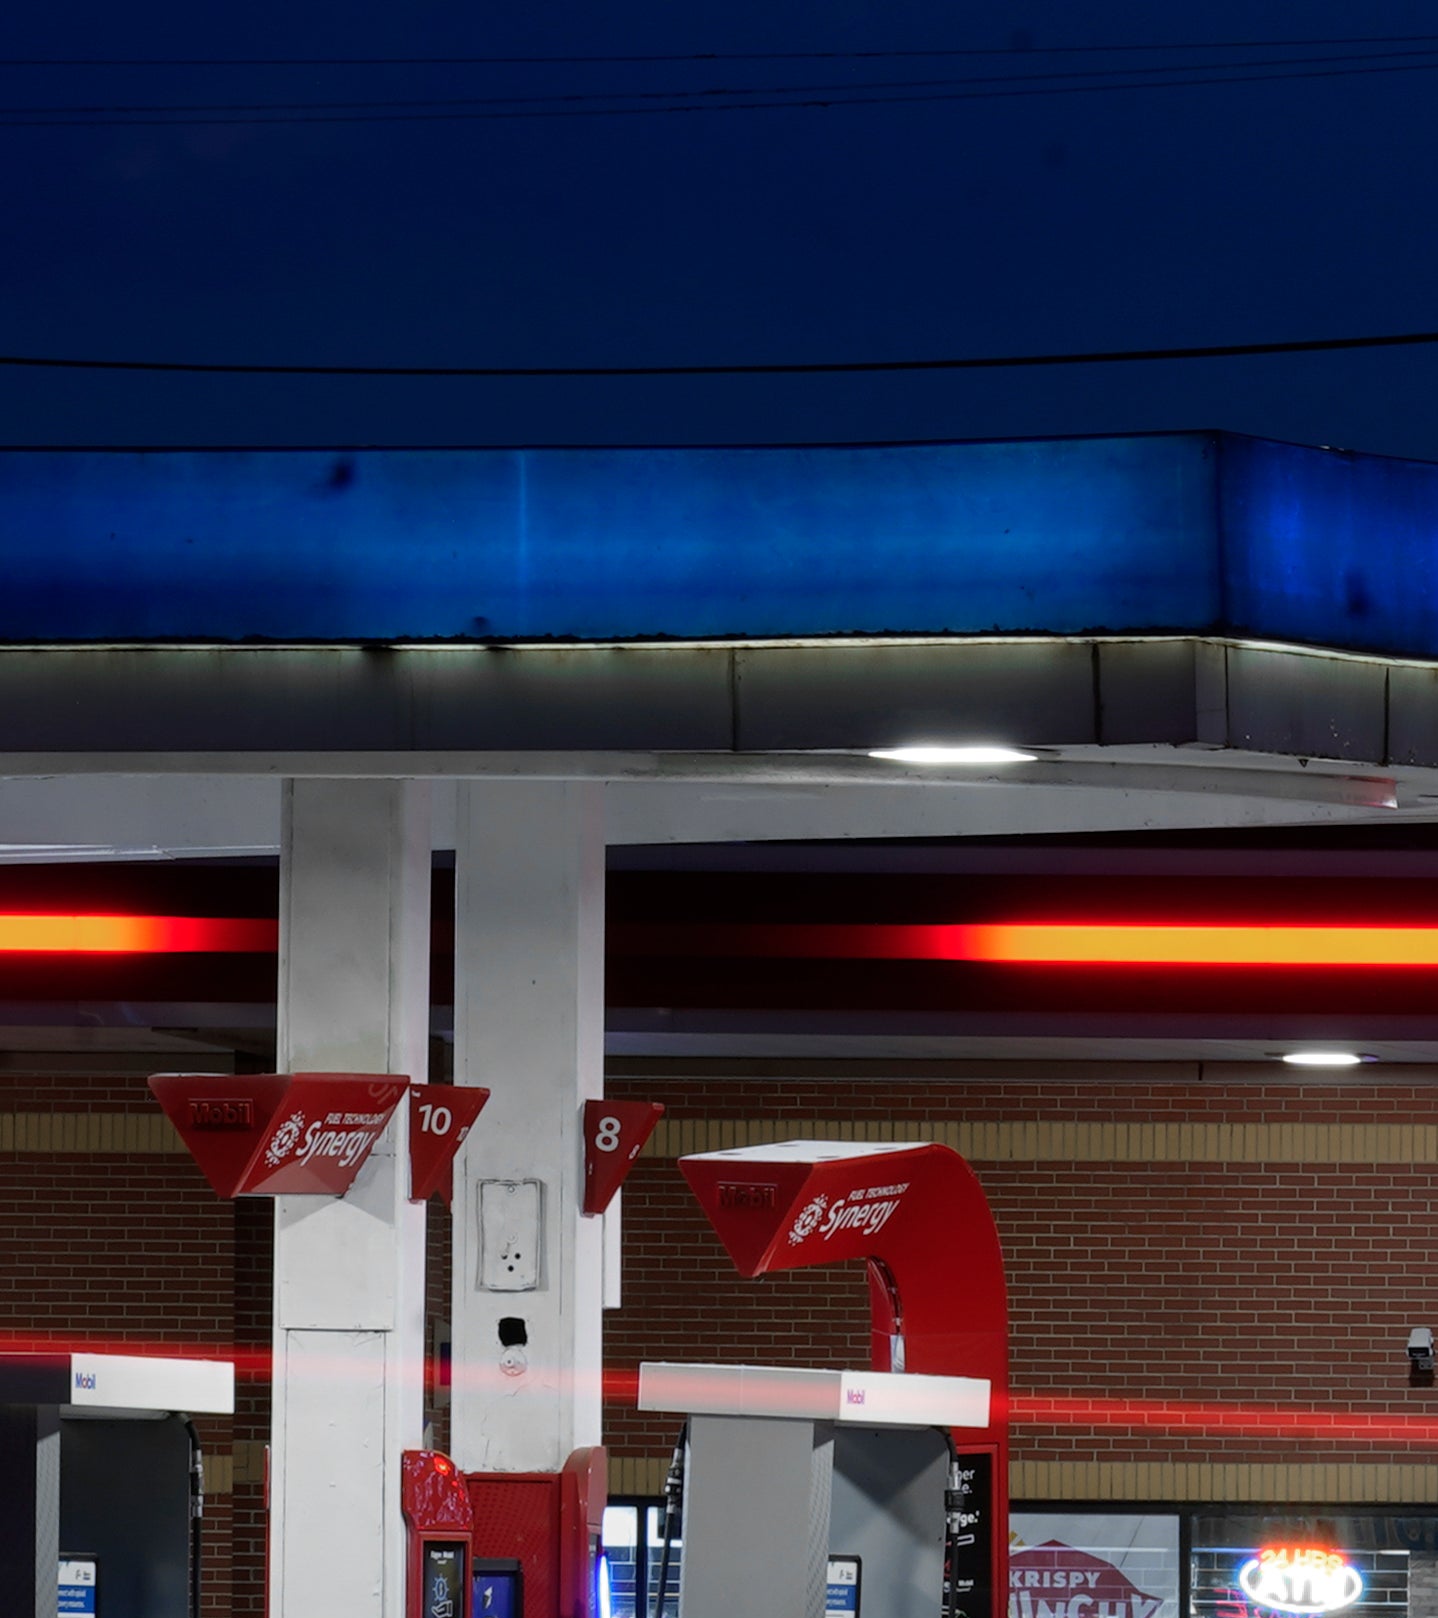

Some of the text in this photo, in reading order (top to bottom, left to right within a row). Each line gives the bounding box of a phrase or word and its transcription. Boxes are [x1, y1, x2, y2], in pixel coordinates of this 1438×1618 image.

[418, 1104, 451, 1135] 10
[595, 1116, 622, 1152] 8
[296, 1121, 378, 1167] Synergy
[819, 1199, 900, 1241] Synergy
[75, 1373, 96, 1389] Mobil
[846, 1389, 865, 1405] Mobil
[1009, 1571, 1100, 1588] KRISPY
